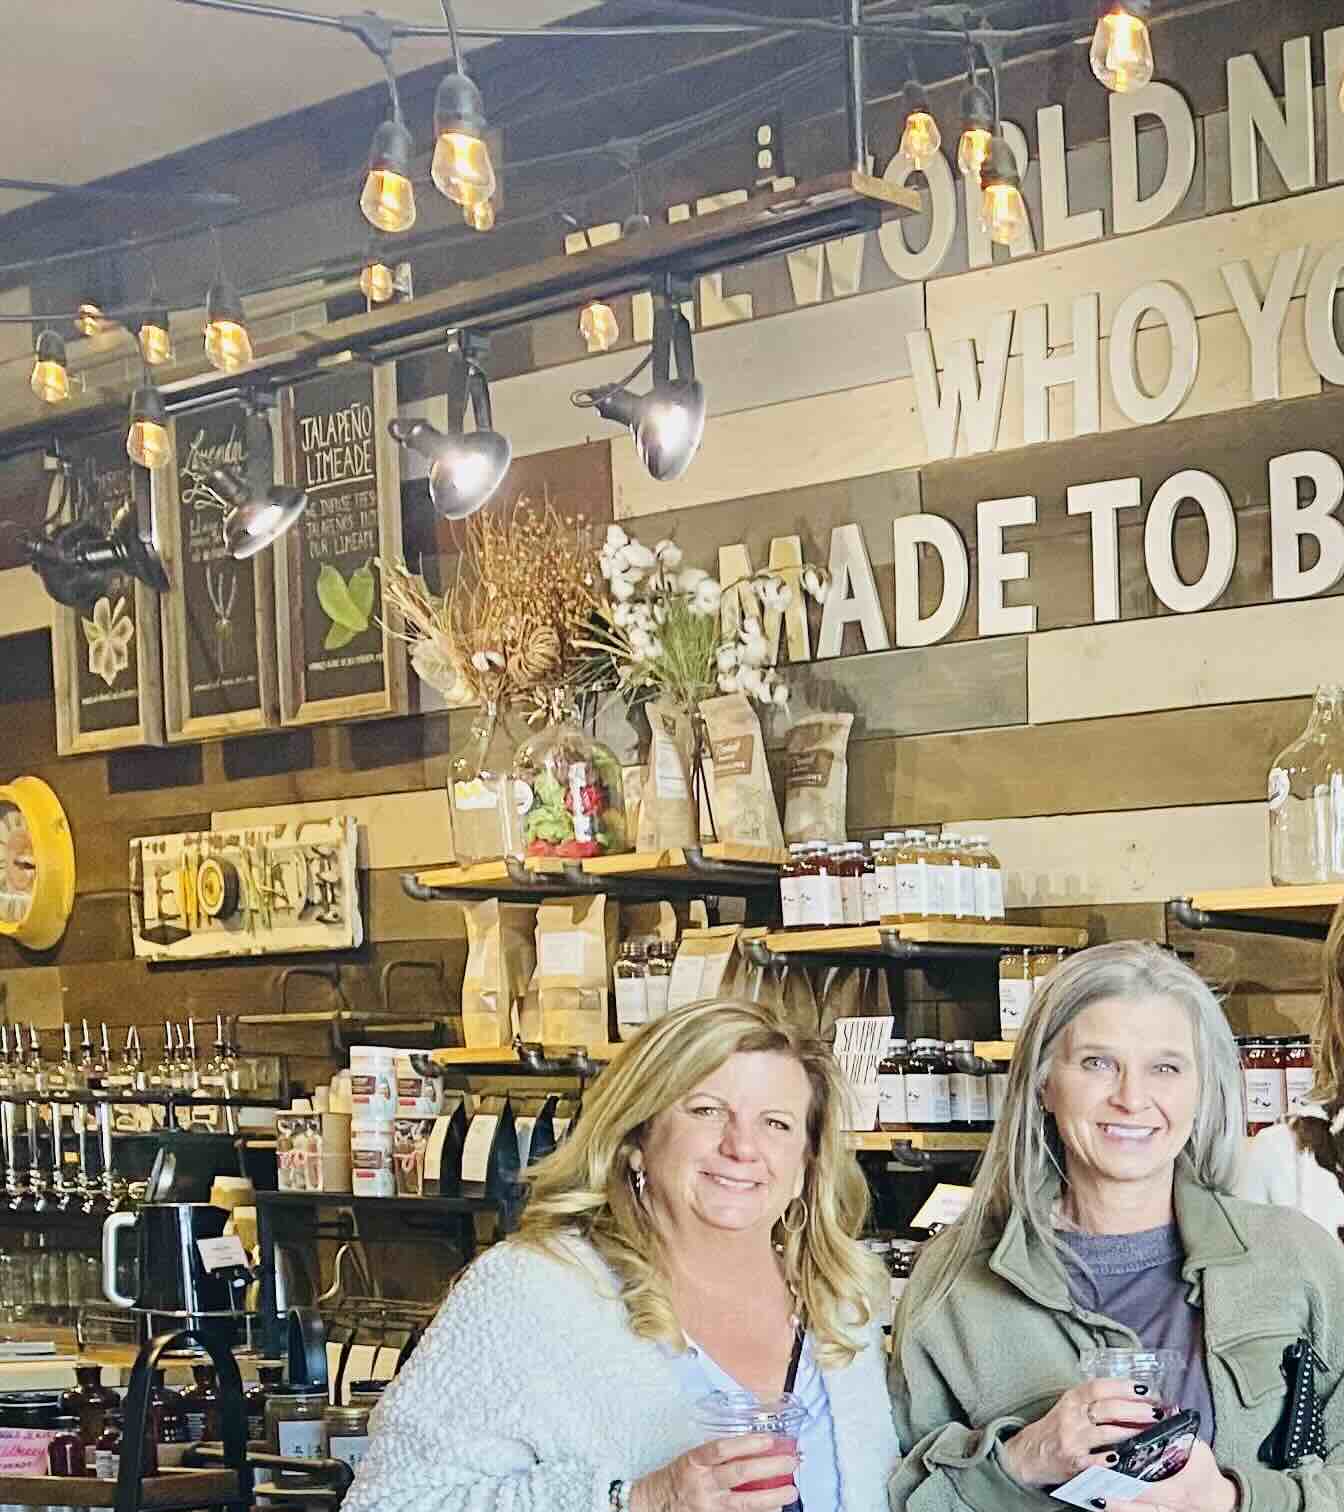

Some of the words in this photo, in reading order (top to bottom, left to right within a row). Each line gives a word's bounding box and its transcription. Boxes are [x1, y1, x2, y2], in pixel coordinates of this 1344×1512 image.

[906, 281, 1200, 457] WHO
[300, 403, 372, 450] JALAPEÑO
[306, 439, 373, 485] LIMEADE
[718, 495, 1037, 662] MADE
[1067, 469, 1237, 622] TO
